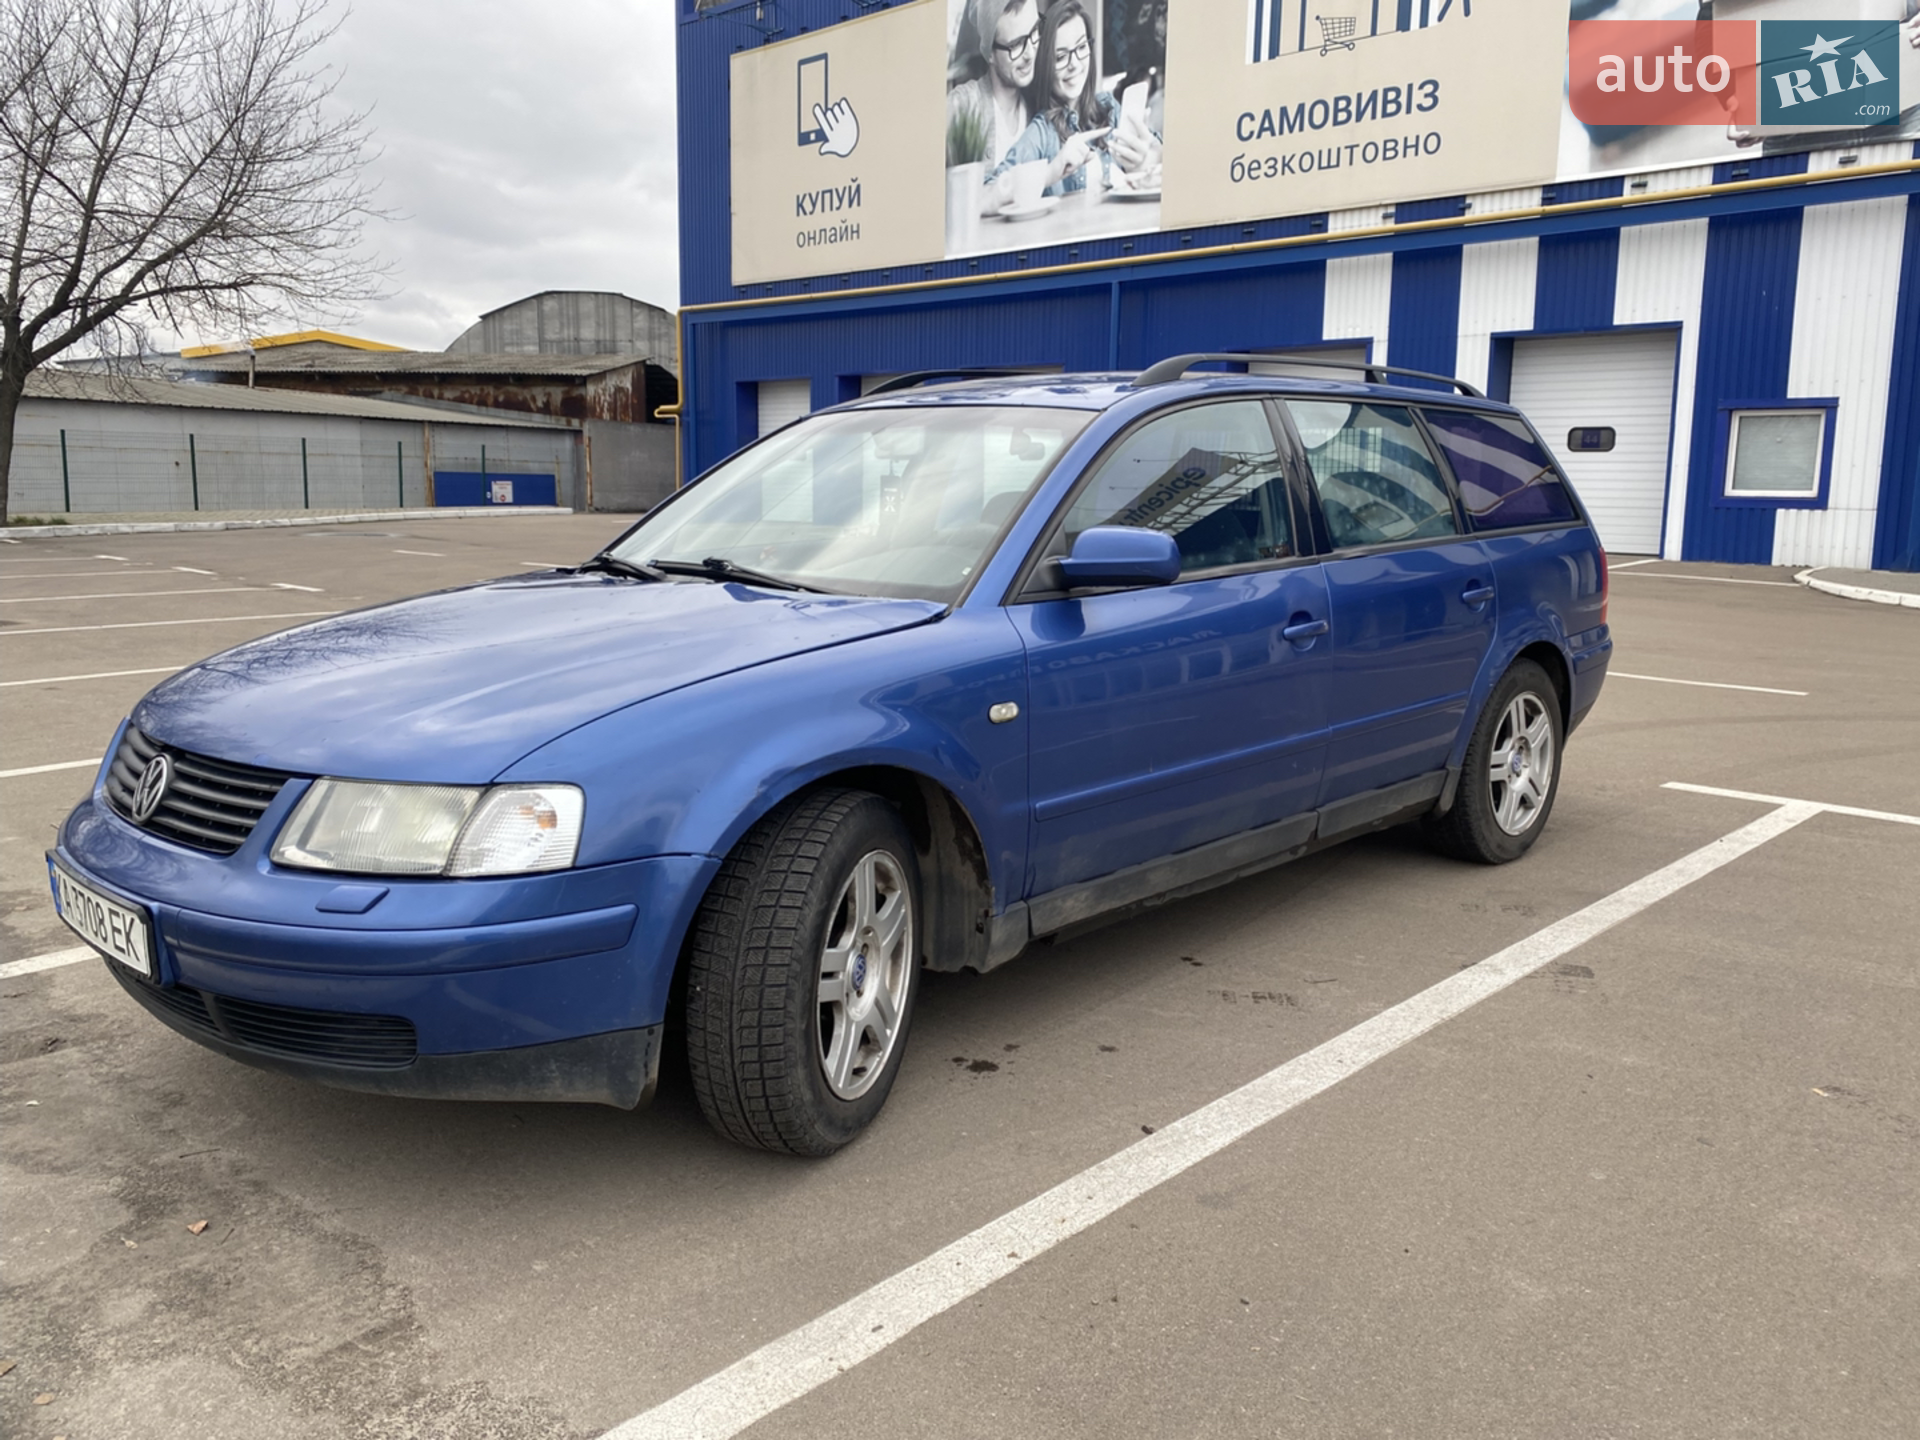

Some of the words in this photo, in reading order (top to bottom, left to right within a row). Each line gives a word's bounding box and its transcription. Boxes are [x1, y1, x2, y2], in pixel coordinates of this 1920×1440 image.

[1236, 79, 1440, 142] САМОВИВІЗ
[1230, 132, 1442, 183] безкоштовно
[796, 177, 861, 217] КУПУЙ
[796, 218, 860, 248] онлайн
[108, 906, 141, 962] EK
